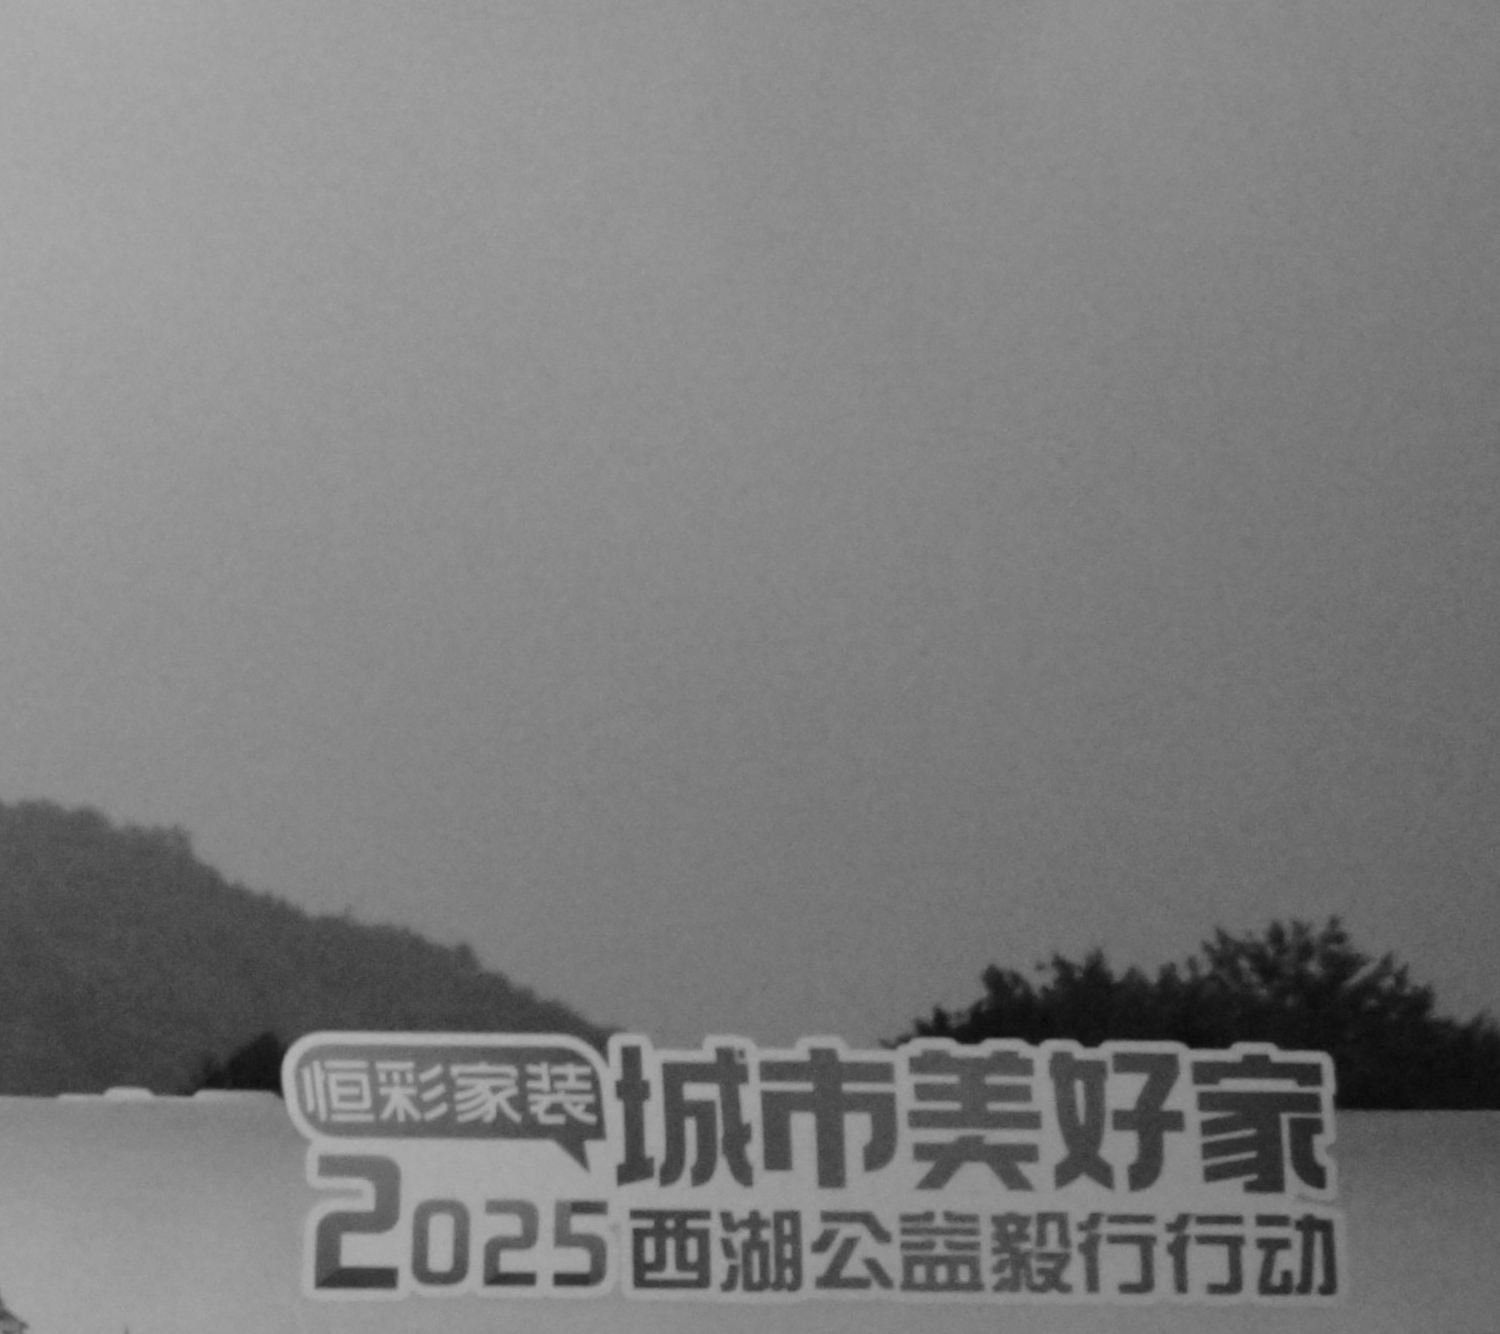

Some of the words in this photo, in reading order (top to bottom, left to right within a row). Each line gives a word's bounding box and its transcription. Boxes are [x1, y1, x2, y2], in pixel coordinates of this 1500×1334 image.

[303, 1060, 599, 1126] 恒彩家装
[615, 1045, 1329, 1193] 城市美好家
